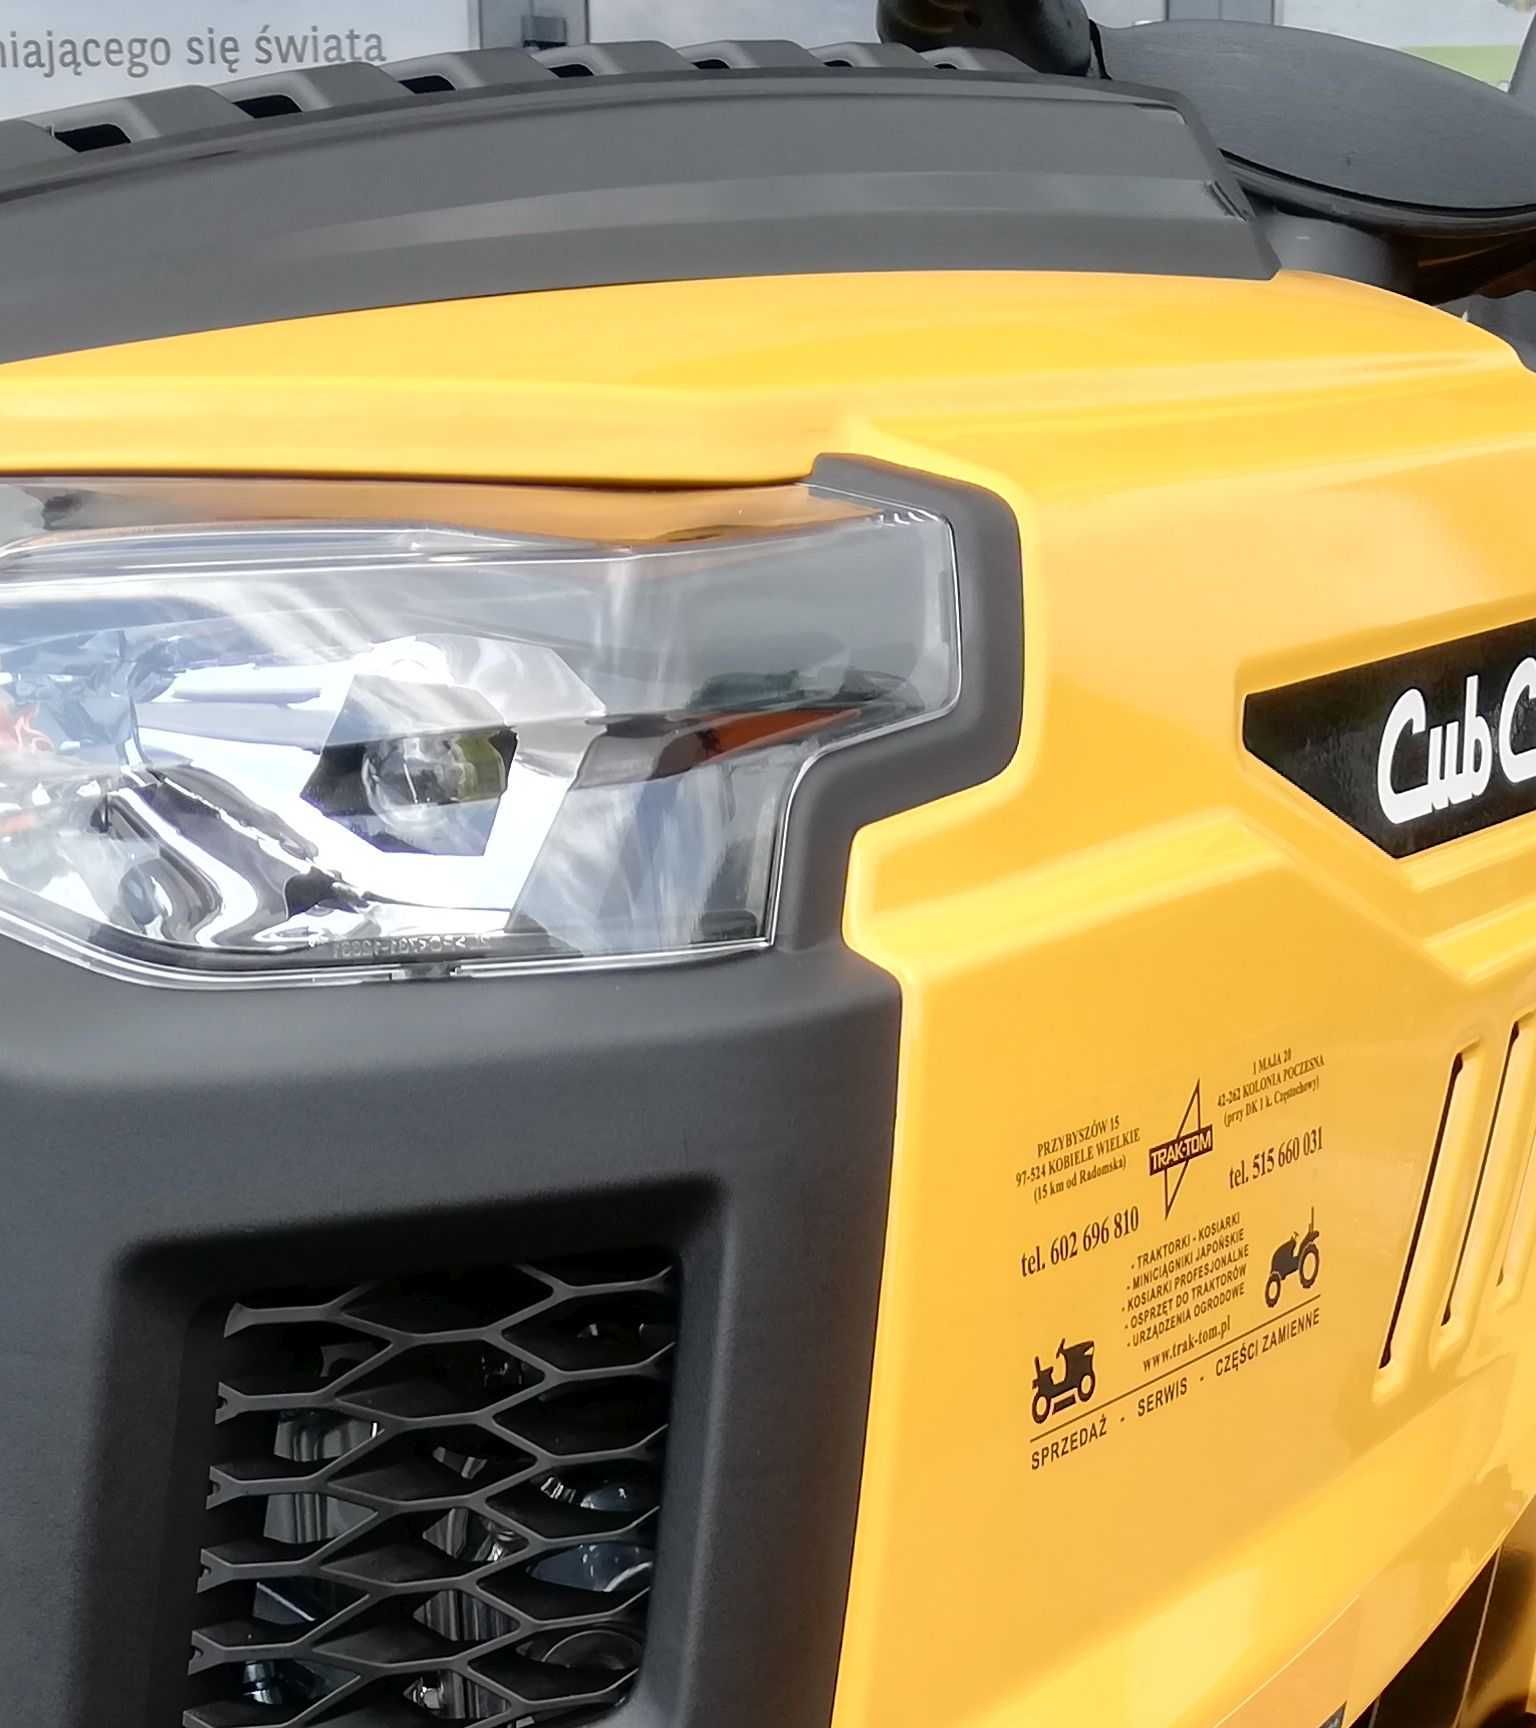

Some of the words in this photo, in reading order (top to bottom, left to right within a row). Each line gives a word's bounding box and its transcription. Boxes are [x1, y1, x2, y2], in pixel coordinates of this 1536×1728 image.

[185, 26, 241, 73] się
[254, 25, 388, 65] świata
[1377, 675, 1493, 824] Cub
[1217, 1087, 1241, 1107] 42-262
[1243, 1073, 1282, 1098] KOLONIA
[1283, 1055, 1325, 1082] POCZESNA
[1258, 1053, 1282, 1073] MAJA
[1037, 1119, 1109, 1159] PRZYBYSZÓW
[1110, 1114, 1120, 1132] 15
[1224, 1109, 1243, 1128] (przy
[1246, 1099, 1258, 1116] DK
[1015, 1166, 1046, 1187] 97-524
[1048, 1145, 1095, 1176] KOBIELE
[1096, 1128, 1141, 1157] WIELKIE
[1033, 1183, 1048, 1204] (15
[1049, 1179, 1065, 1196] km
[1066, 1172, 1078, 1189] od
[1079, 1154, 1127, 1185] Radomska)
[1229, 1157, 1249, 1190] tel.
[1252, 1147, 1276, 1181] 515
[1278, 1136, 1300, 1168] 660
[1303, 1126, 1324, 1157] 031
[1020, 1243, 1047, 1278] tel.
[1049, 1228, 1080, 1268] 602
[1082, 1214, 1112, 1255] 696
[1113, 1205, 1140, 1244] 810
[1132, 1252, 1193, 1291] MINICIĄGNIKI
[1196, 1228, 1245, 1262] JAPOŃSKIE
[1137, 1233, 1192, 1269] TRAKTORKI
[1198, 1212, 1241, 1241] KOSIARKI
[1127, 1283, 1173, 1312] KOSIARKI
[1174, 1244, 1249, 1290] PROFESJONALNE
[1130, 1298, 1174, 1329] OSPRZĘT
[1176, 1291, 1189, 1308] DO
[1191, 1264, 1248, 1301] TRAKTORÓW
[1132, 1311, 1192, 1347] URZĄDZENIA
[1193, 1282, 1245, 1318] OGRODOWE
[1142, 1314, 1232, 1373] www.trak-tom.pl
[1031, 1414, 1108, 1470] SPRZEDAŻ
[1137, 1375, 1188, 1418] SERWIS
[1215, 1339, 1259, 1378] CZĘŚCI
[1261, 1306, 1321, 1354] ZAMIENNE
